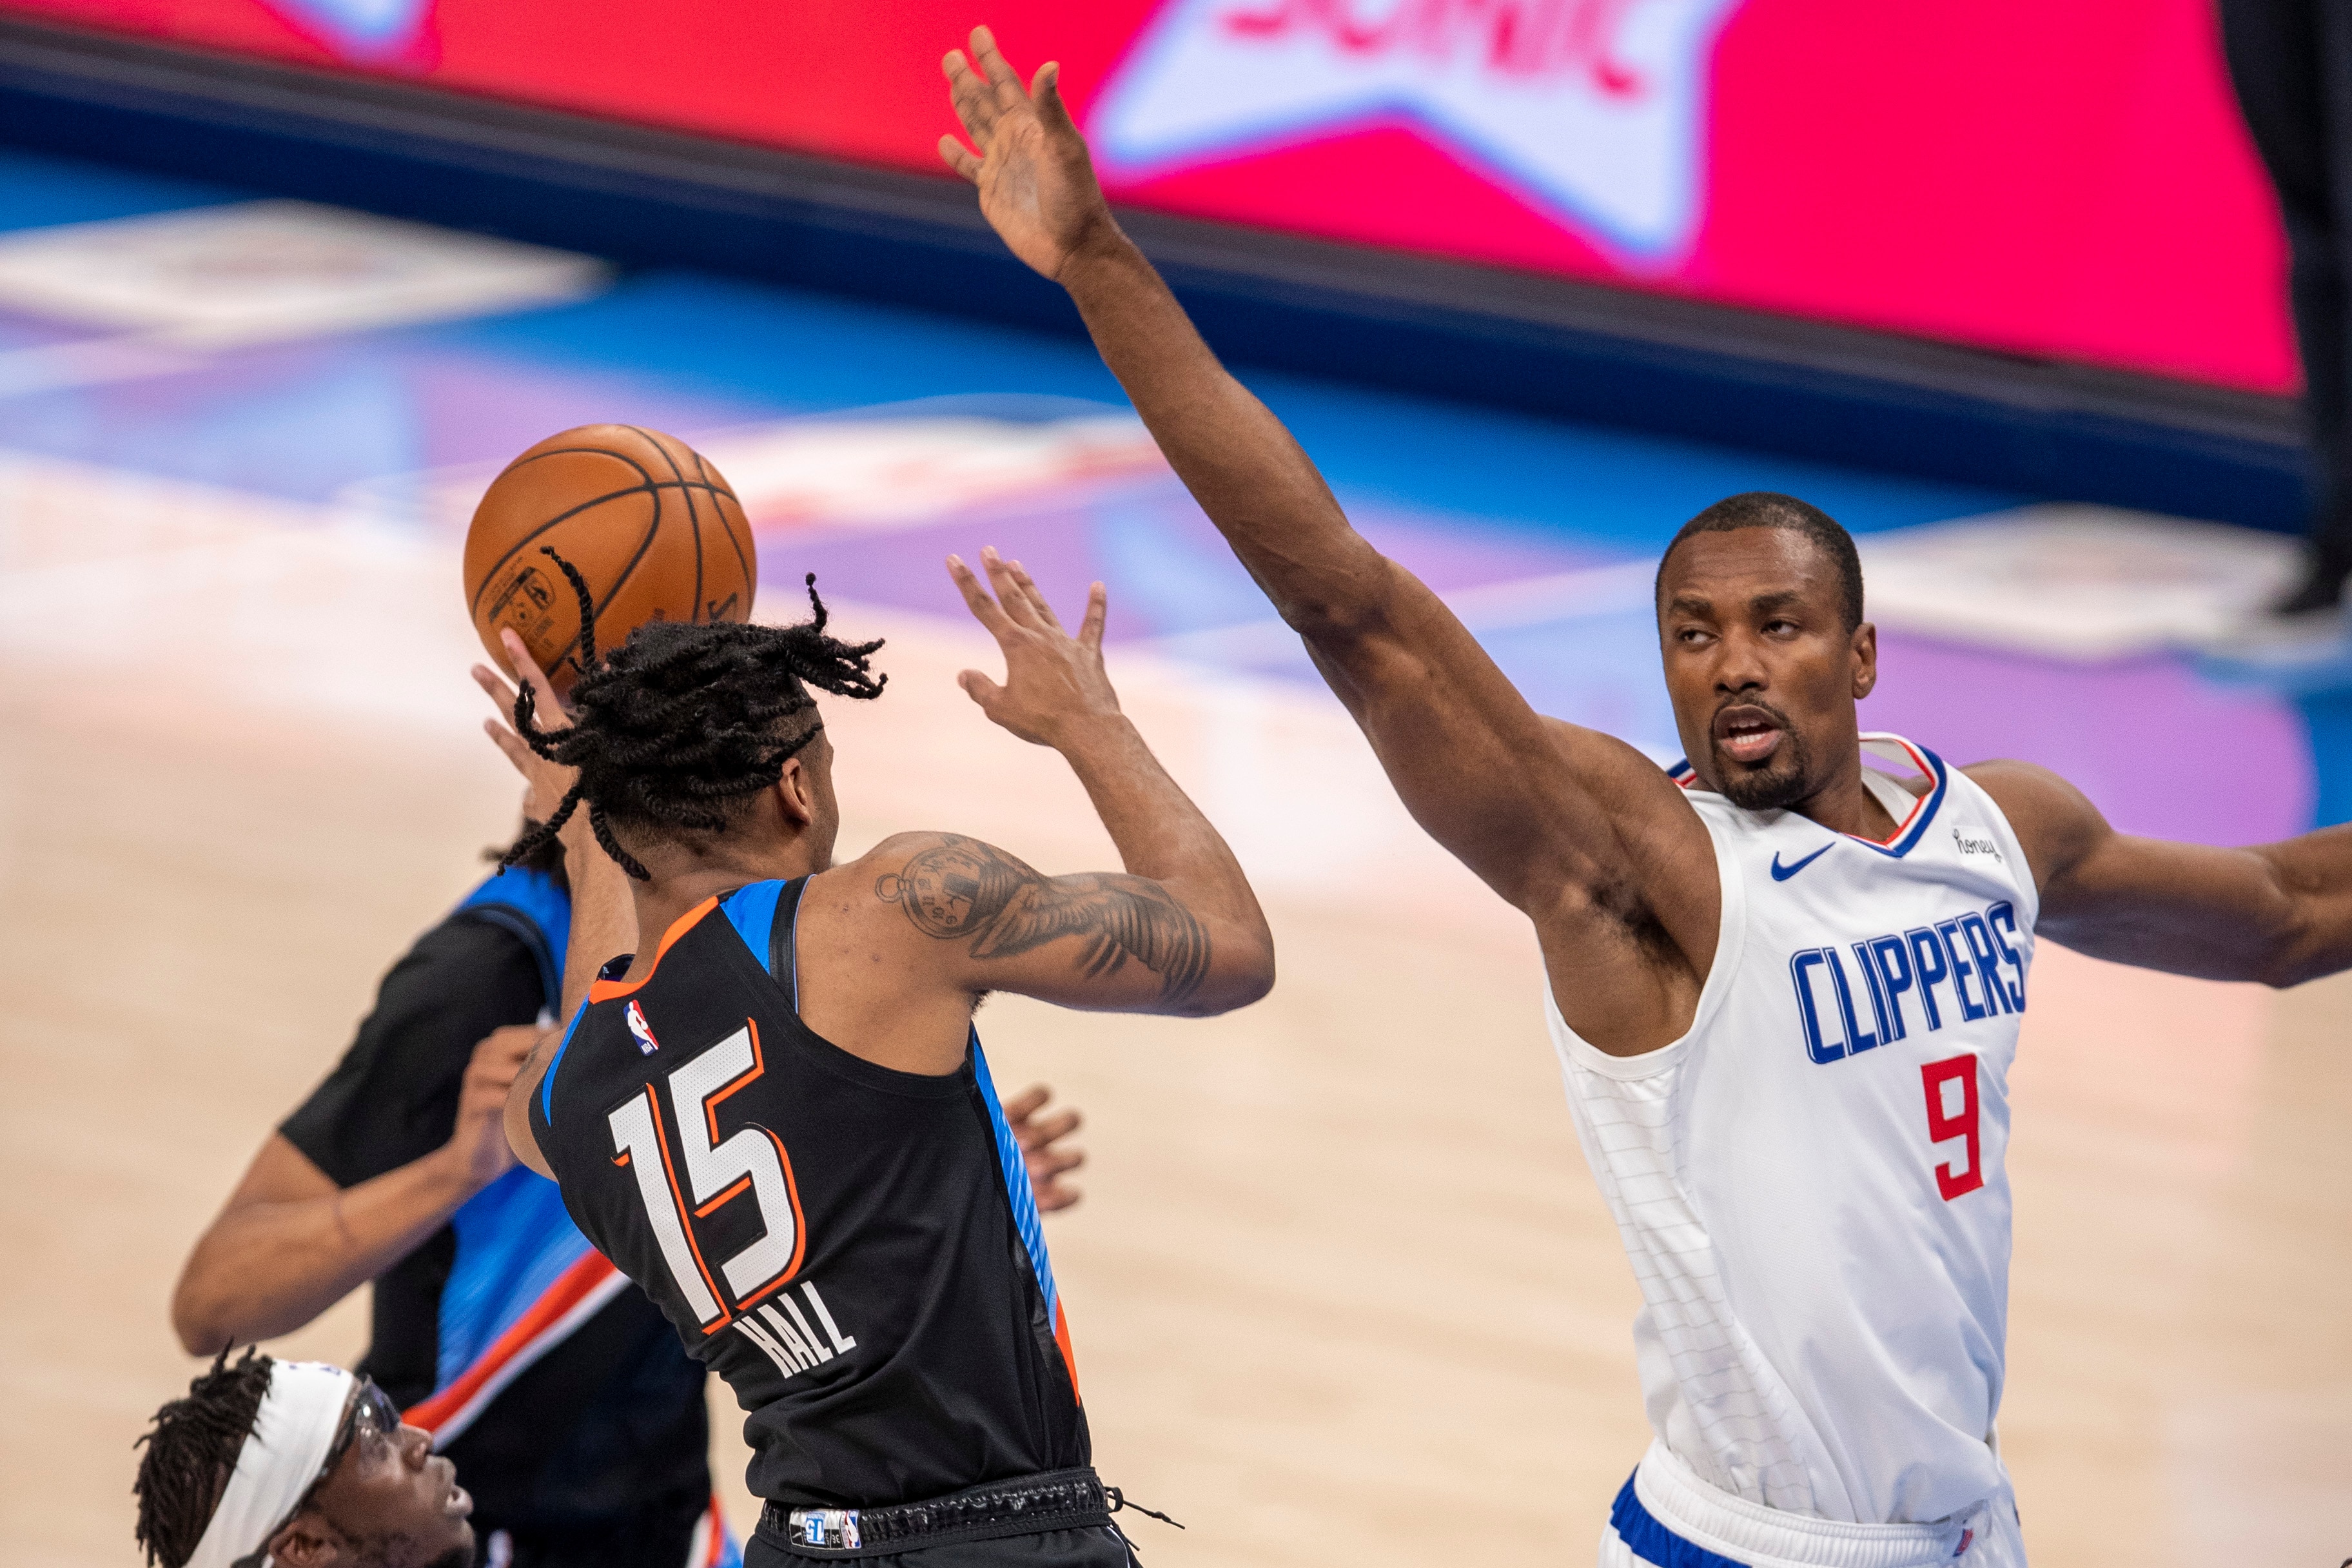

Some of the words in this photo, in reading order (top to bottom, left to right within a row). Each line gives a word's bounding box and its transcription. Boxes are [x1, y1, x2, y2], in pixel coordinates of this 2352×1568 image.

[1952, 828, 2003, 863] honey
[1789, 900, 2026, 1064] CLIPPERS
[641, 1041, 653, 1055] NBA
[607, 1017, 806, 1335] 15
[1920, 1052, 1984, 1202] 9
[732, 1280, 858, 1380] HALL
[805, 1520, 824, 1541] 15
